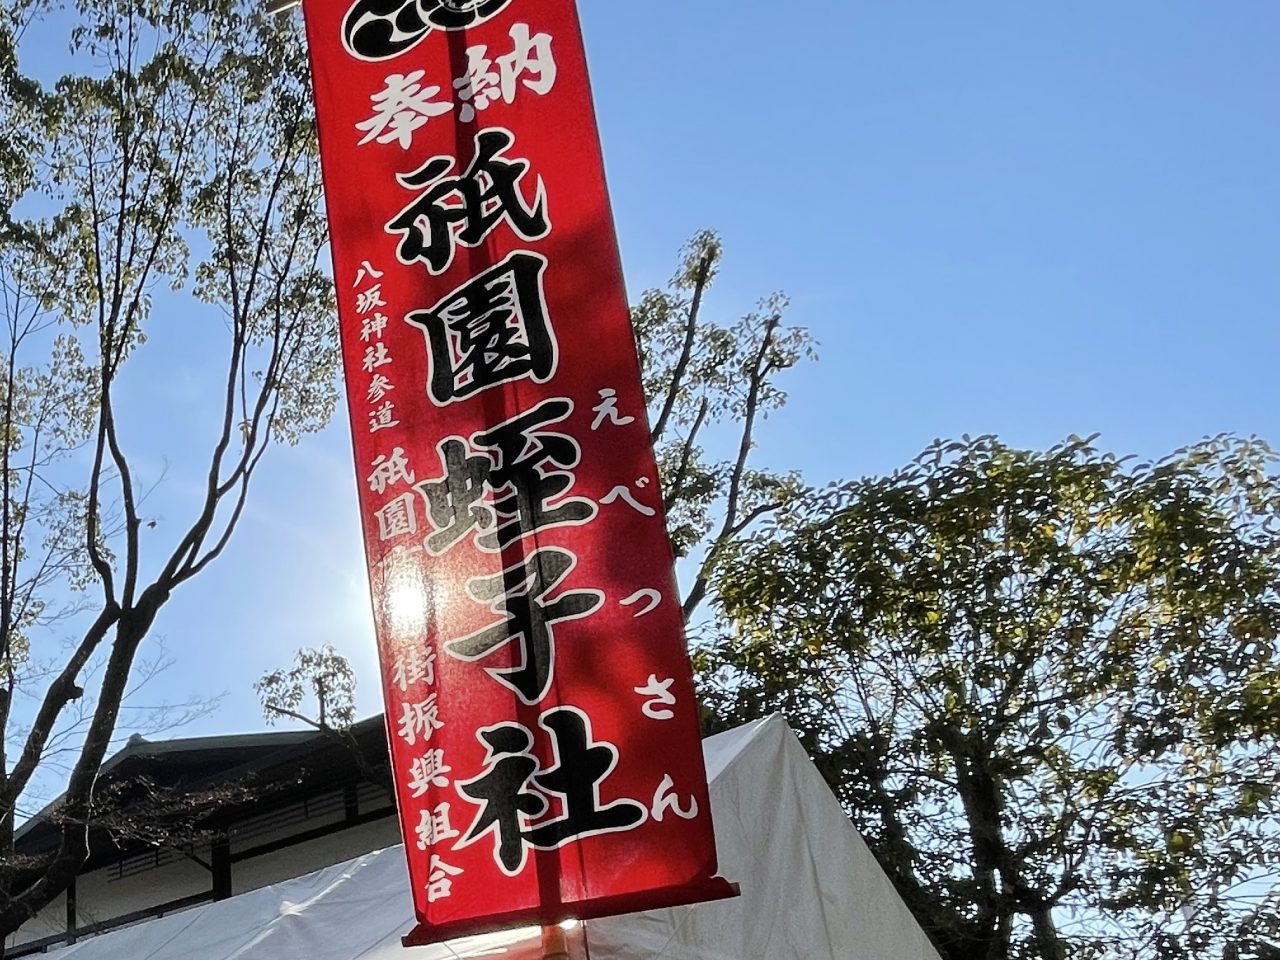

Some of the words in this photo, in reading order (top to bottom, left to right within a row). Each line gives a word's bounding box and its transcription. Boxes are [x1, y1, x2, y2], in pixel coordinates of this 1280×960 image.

[356, 22, 557, 150] 奉納
[591, 388, 698, 821] えべっさん
